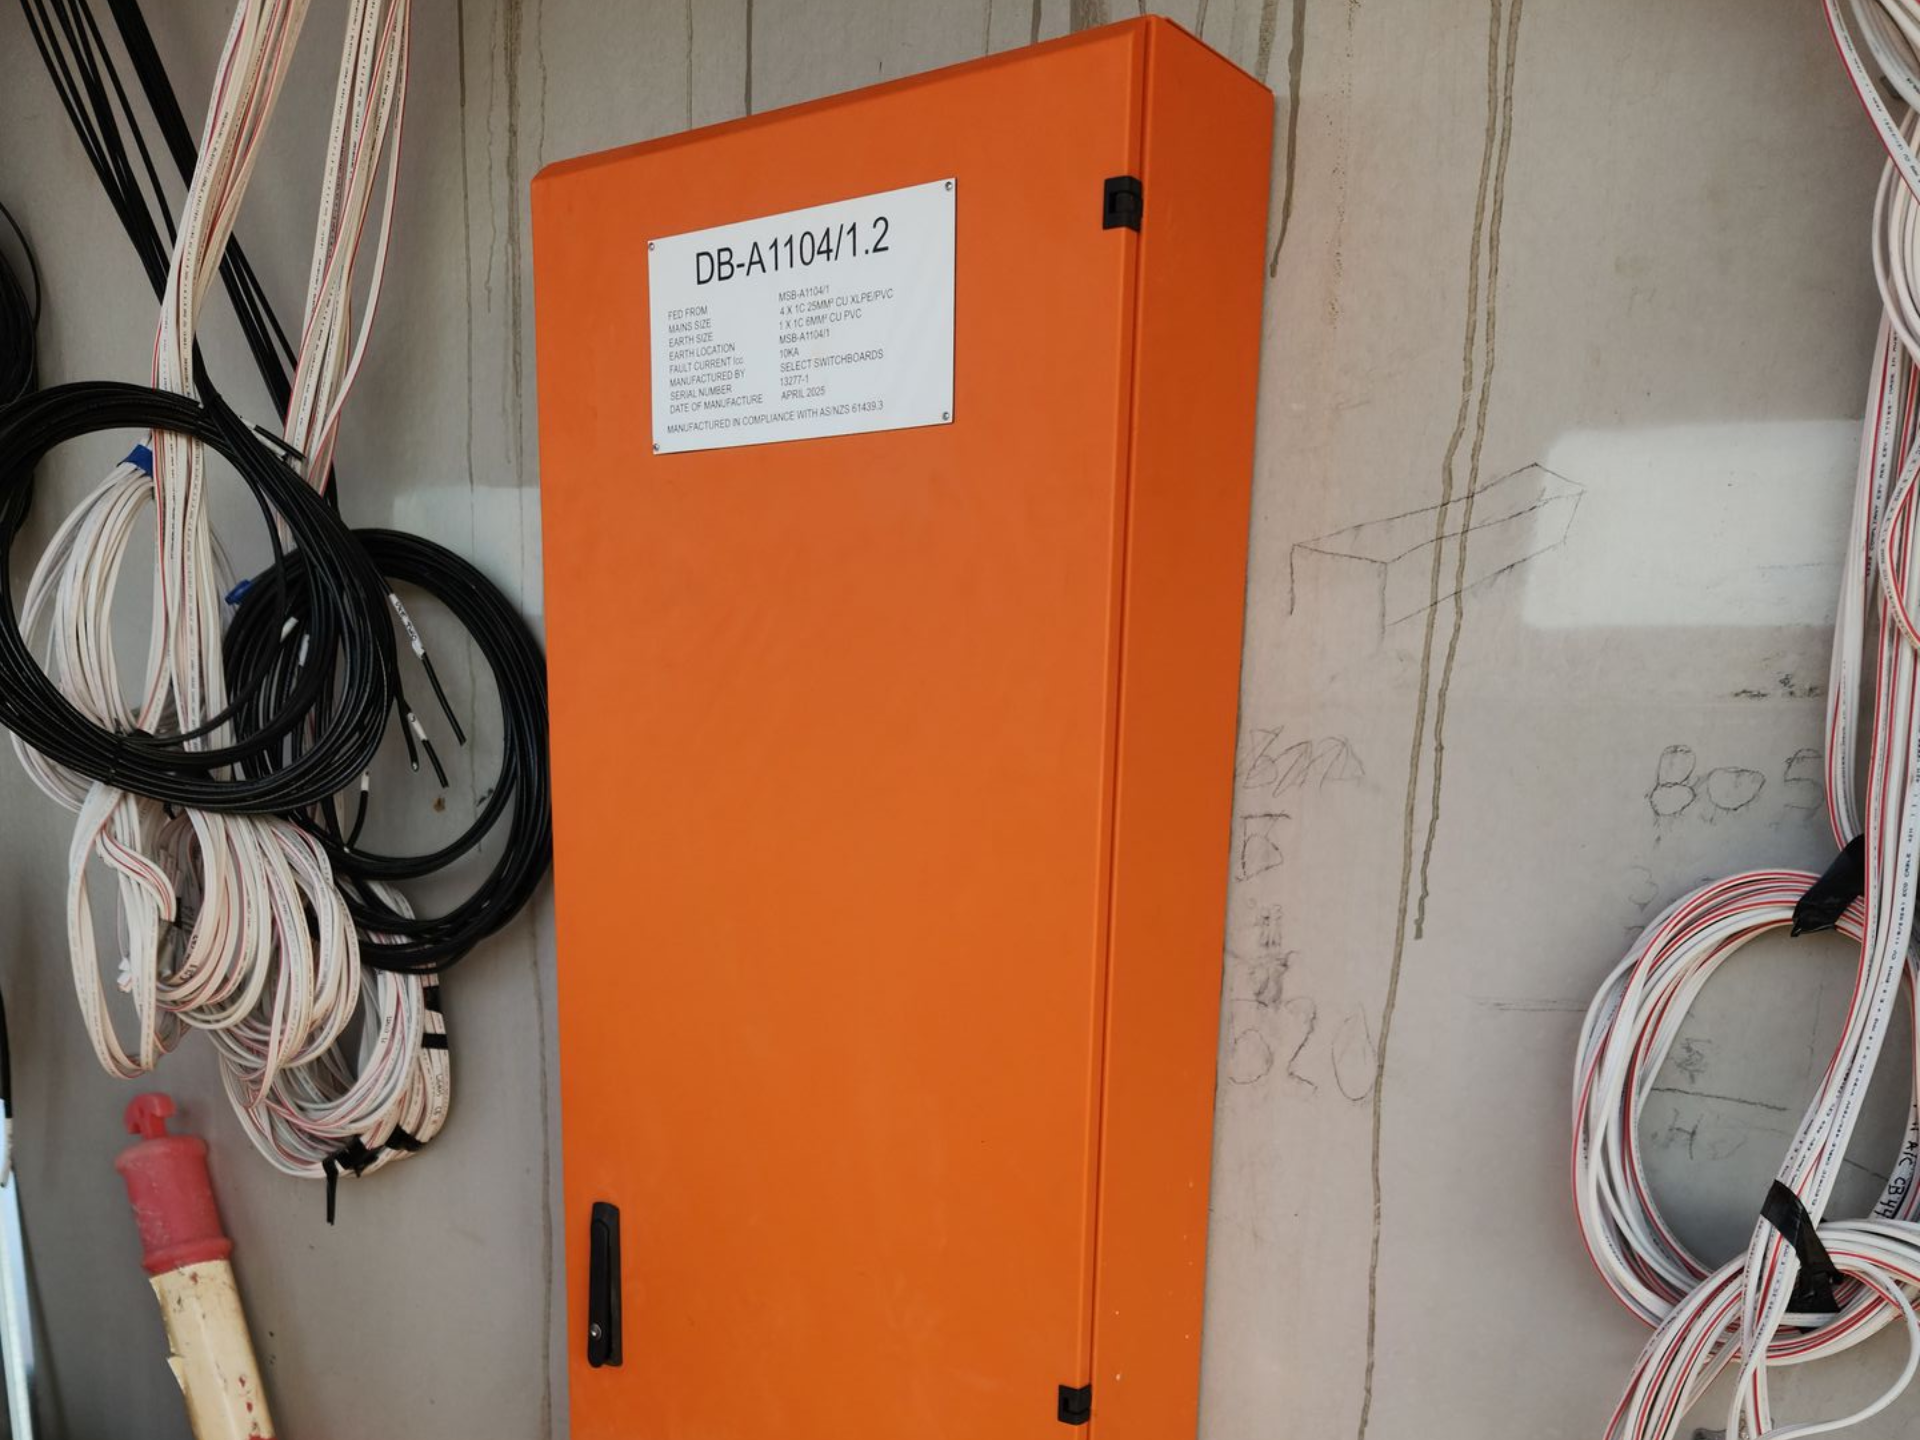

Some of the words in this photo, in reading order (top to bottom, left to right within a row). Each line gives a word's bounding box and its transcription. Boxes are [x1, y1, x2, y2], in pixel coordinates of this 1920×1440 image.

[696, 216, 889, 286] DB-A1104/1.2
[778, 285, 830, 303] MSB-A1104/1
[667, 309, 684, 320] FED
[685, 305, 708, 317] FROM
[779, 308, 785, 316] 4
[787, 305, 793, 316] X
[795, 303, 805, 314] 1C
[835, 295, 849, 307] CU
[668, 322, 693, 333] MAINS
[694, 318, 711, 330] SIZE
[786, 319, 792, 330] X
[793, 318, 804, 329] 1C
[829, 311, 842, 323] CU
[843, 308, 862, 320] PVC
[668, 336, 694, 348] EARTH
[696, 332, 713, 344] SIZE
[779, 328, 830, 344] MSB-A1104/1
[669, 350, 694, 361] EARTH
[696, 342, 736, 358] LOCATION
[780, 347, 800, 359] 10KA
[780, 358, 812, 373] SELECT
[814, 348, 884, 368] SWITCHBOARDS
[669, 362, 692, 374] FAULT
[694, 356, 732, 371] CURRENT
[670, 371, 733, 387] MANUFACTURED
[734, 368, 746, 379] BY
[780, 374, 809, 387] 13277-1
[670, 389, 697, 401] SERIAL
[698, 384, 732, 397] NUMBER
[781, 388, 804, 401] APRIL
[806, 385, 826, 398] 2025
[670, 402, 690, 414] DATE
[691, 401, 702, 412] OF
[703, 394, 763, 410] MANUFACTURE
[667, 418, 731, 434] MANUFACTURED
[732, 417, 741, 427] IN
[742, 410, 795, 426] COMPLIANCE
[796, 408, 818, 420] WITH
